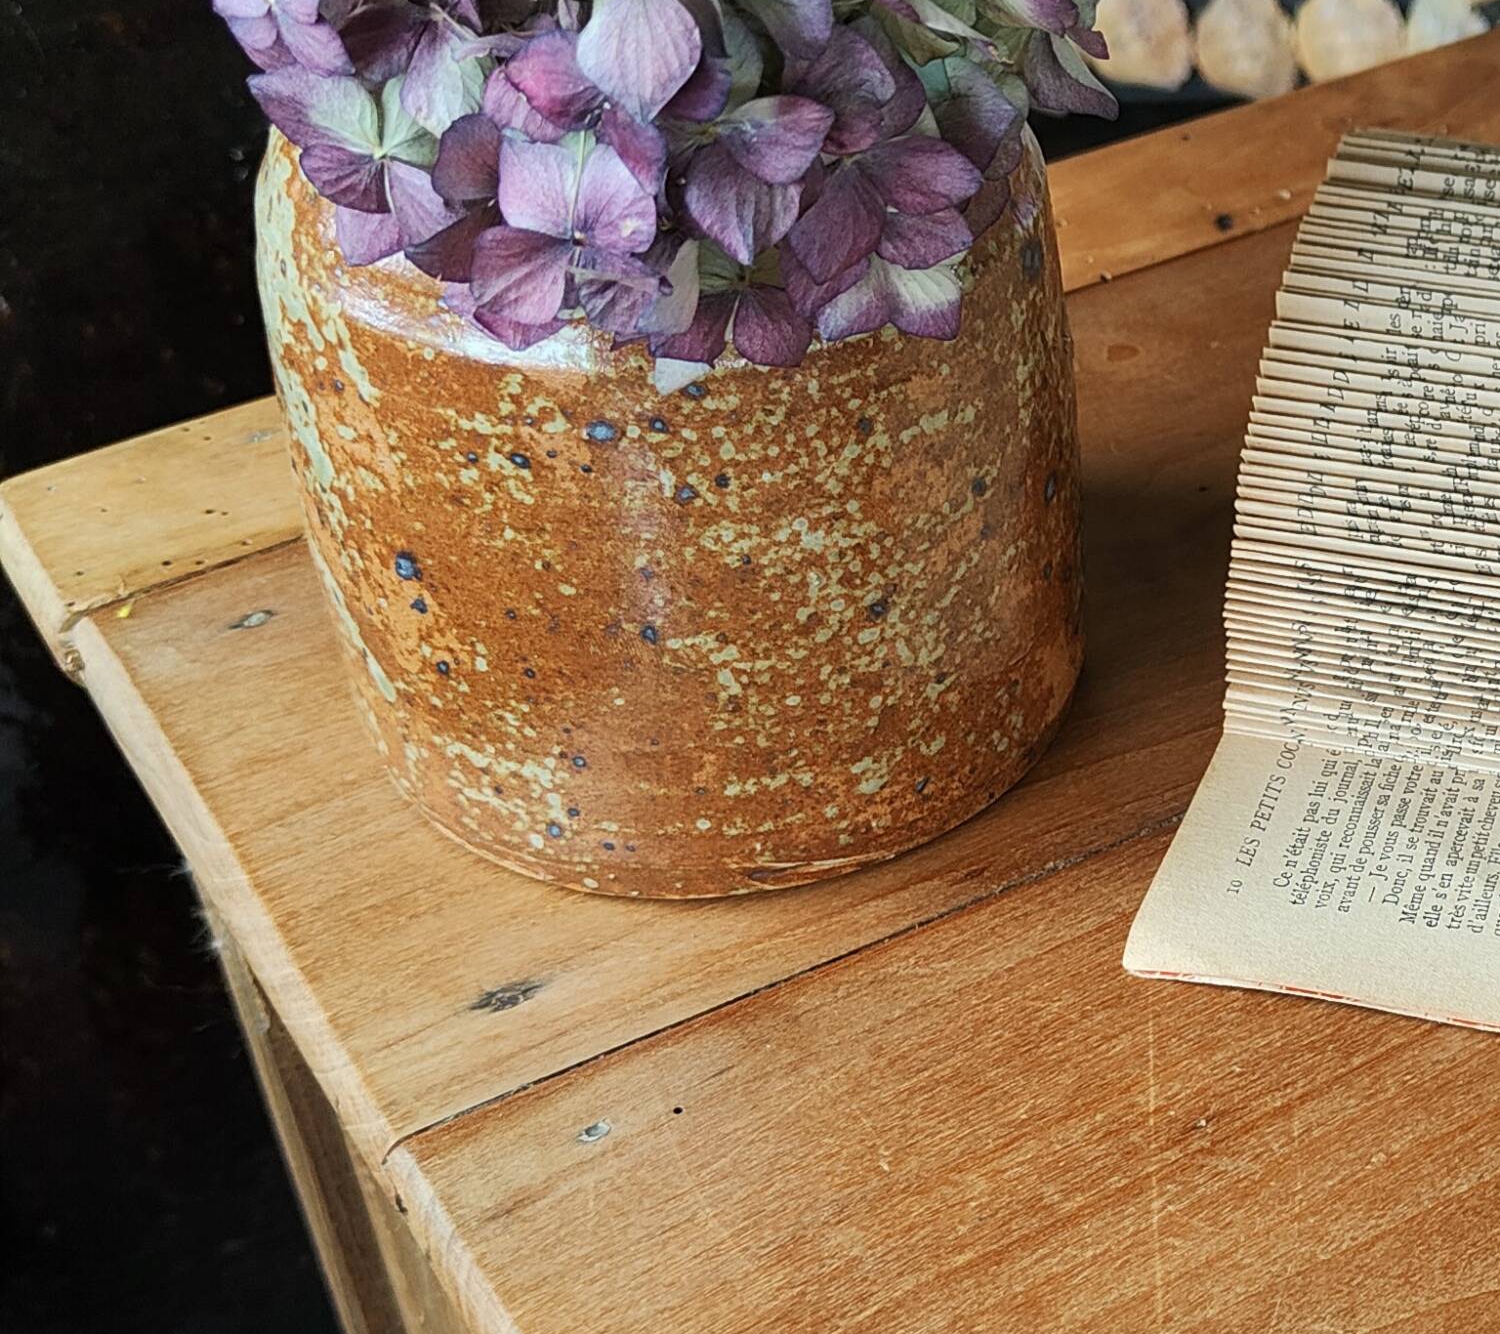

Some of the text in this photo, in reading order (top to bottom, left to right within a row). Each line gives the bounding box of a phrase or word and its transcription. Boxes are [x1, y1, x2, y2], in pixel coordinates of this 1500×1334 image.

[1235, 837, 1261, 867] LES
[1250, 774, 1286, 832] PETITS
[1272, 758, 1338, 888] Ce n'était pas lui qui
[1289, 759, 1363, 905] téléphoniste du journal,
[1314, 758, 1383, 909] voix, qui reconnaissait la
[1337, 764, 1402, 913] avant de pousser sa fiche
[1368, 764, 1424, 882] Je vous passe votre
[1381, 770, 1445, 907] Donc, se trouvait au
[1398, 787, 1460, 924] Même quand n'avait
[1422, 778, 1486, 928] elle s'en apercevait sa
[1470, 831, 1490, 861] petit
[1445, 904, 1467, 930] très
[1454, 875, 1476, 902] vite
[1466, 871, 1500, 934] d'ailleurs.
